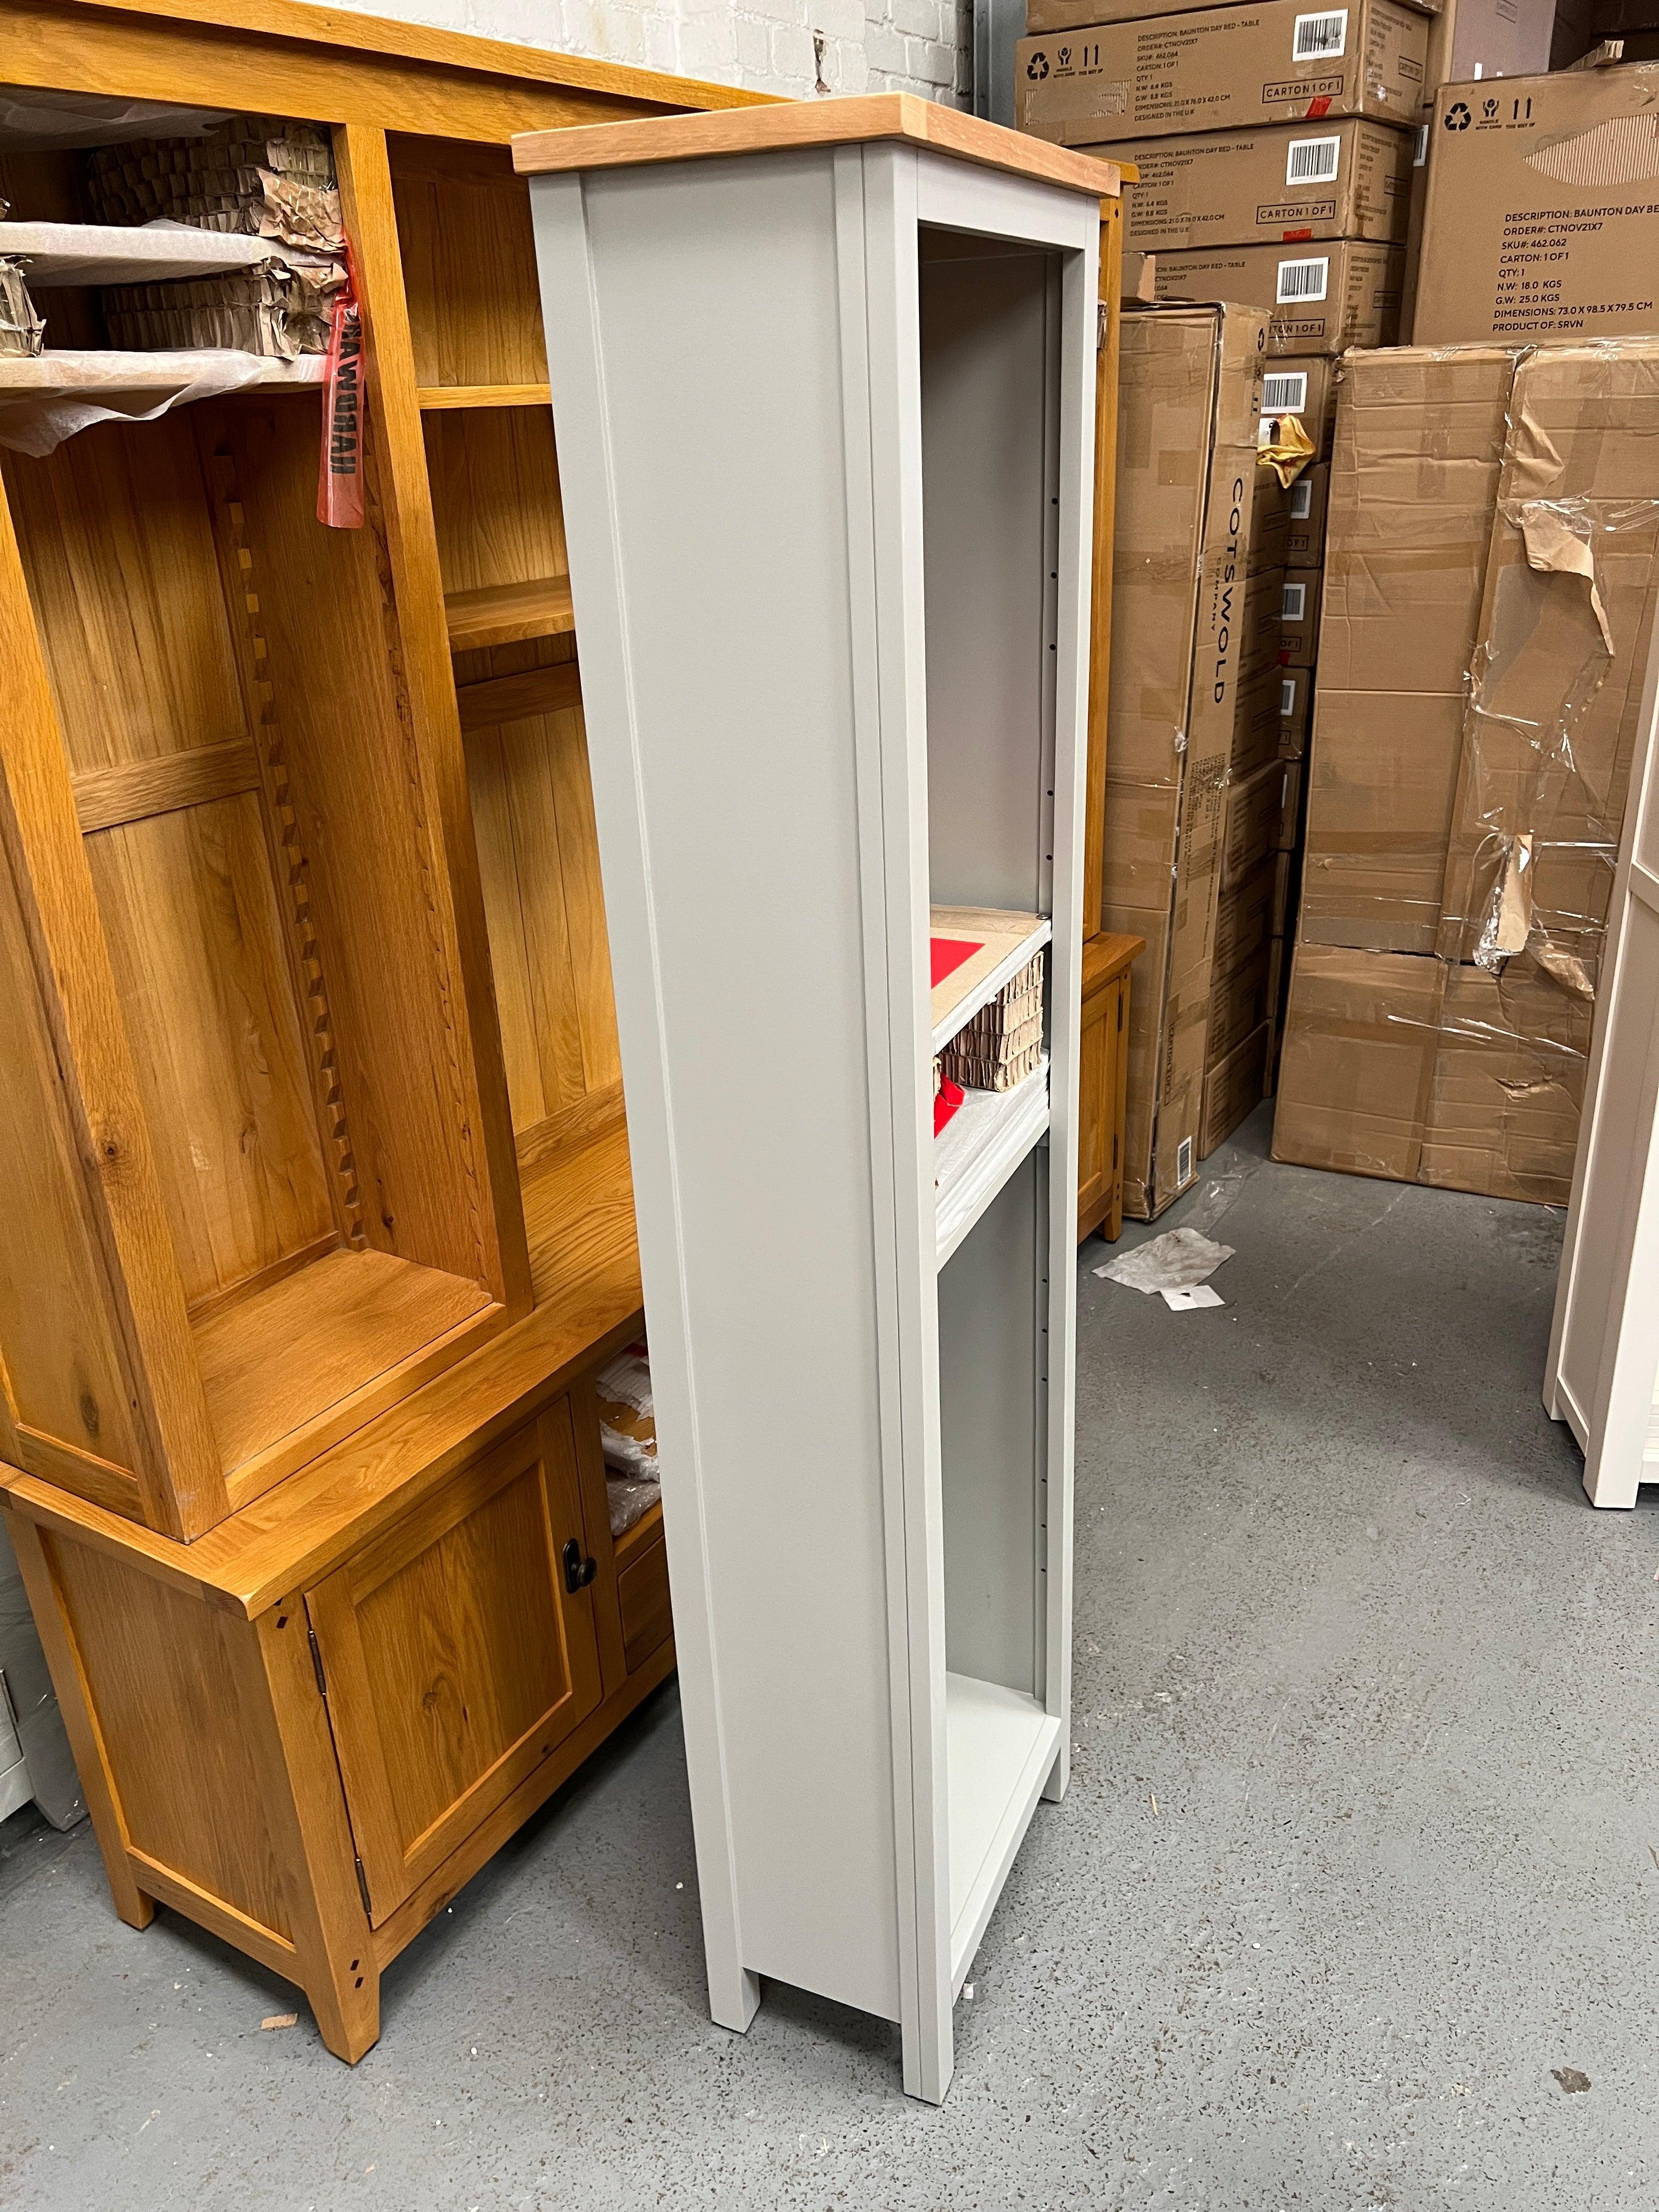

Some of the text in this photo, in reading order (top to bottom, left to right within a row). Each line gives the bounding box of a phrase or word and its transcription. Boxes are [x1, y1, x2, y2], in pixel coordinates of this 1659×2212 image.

[1138, 31, 1179, 42] DESCRIPTION:
[1180, 26, 1209, 36] BAUNTON
[1267, 80, 1339, 97] CARTON 1 OF 1
[1135, 113, 1164, 121] DESIGNED
[1134, 151, 1175, 161] DESCRIPTION:
[1175, 149, 1204, 157] BAUNTON
[1260, 208, 1302, 218] CARTON
[1312, 206, 1326, 215] OF
[1505, 210, 1572, 222] DESCRIPTION:
[1574, 207, 1623, 218] BAUNTON
[1625, 205, 1645, 216] DAY
[1503, 222, 1603, 236] ORDER#: CTNOV21X7
[1502, 238, 1567, 250] SKU#: 462.062
[1500, 252, 1569, 263] CARTON: 1 OF 1
[1169, 264, 1197, 272] BAUNTON
[1499, 268, 1525, 278] QTY: 1
[1497, 280, 1562, 291] N.W: 18.0 KGS
[1496, 294, 1560, 305] G.W: 25.0 KGS
[1494, 301, 1653, 318] DIMENSIONS: 73.0 X 98.5 X 79.5 CM
[1492, 320, 1583, 332] PRODUCT OF: SRVN
[1214, 477, 1243, 704] COTSWOLD
